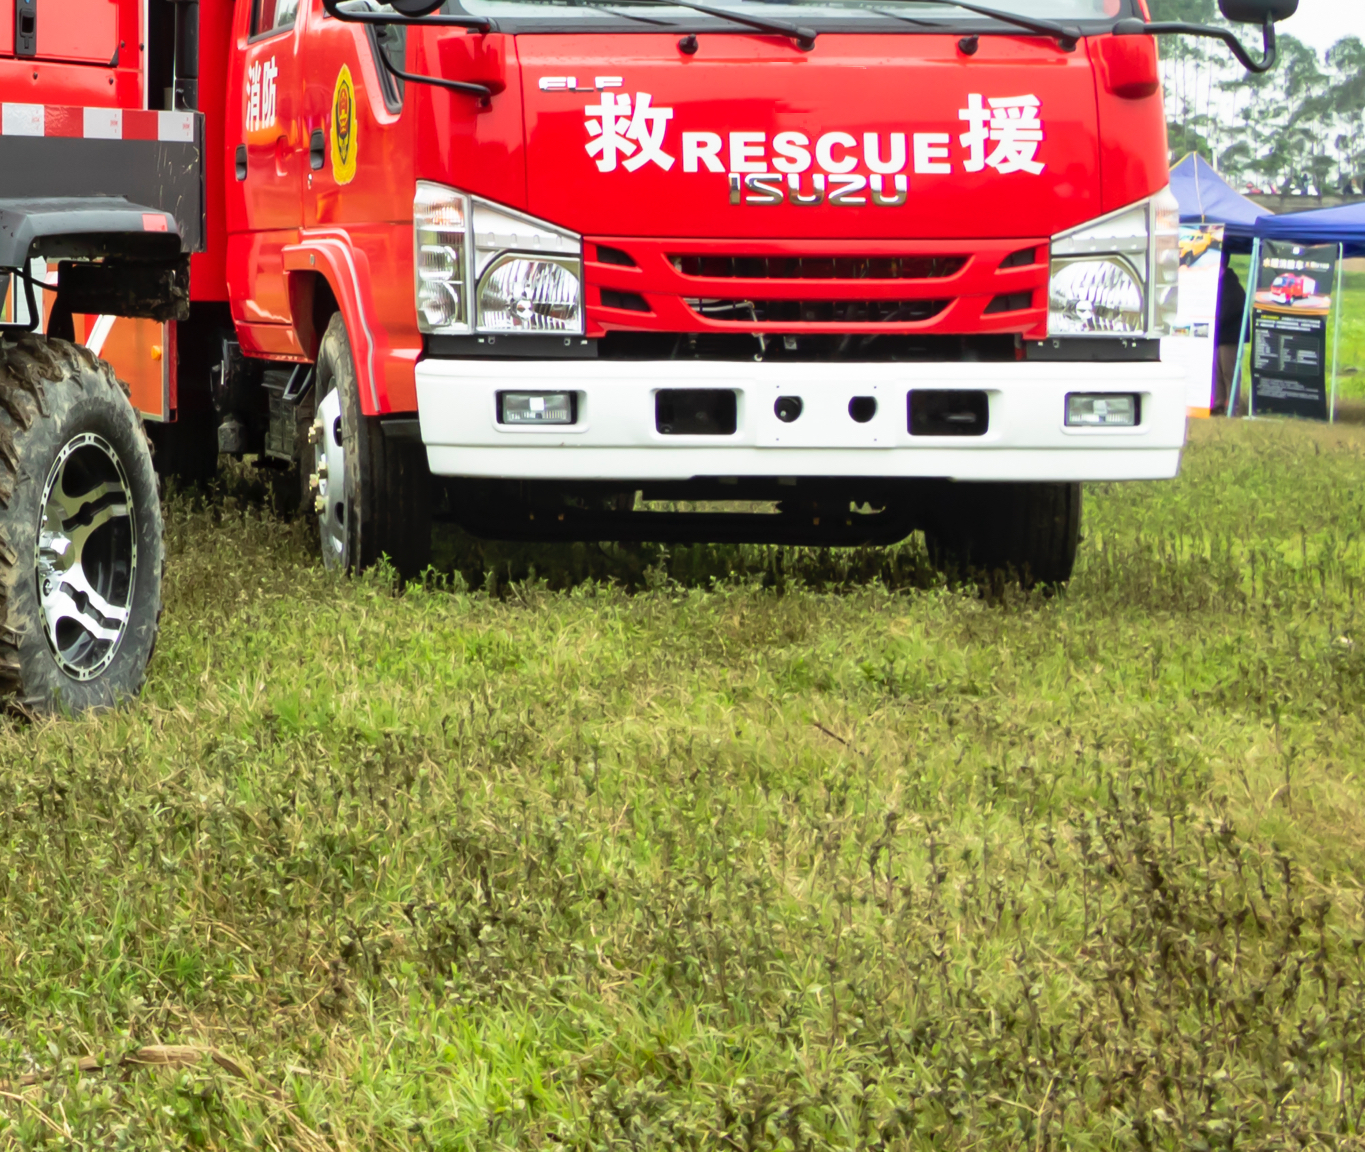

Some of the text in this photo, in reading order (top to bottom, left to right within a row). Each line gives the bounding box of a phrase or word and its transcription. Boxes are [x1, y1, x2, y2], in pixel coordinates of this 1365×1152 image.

[245, 55, 279, 132] 消防
[538, 76, 624, 92] ELF
[584, 91, 1047, 175] 救 RESCUE 援
[728, 173, 909, 207] ISUZU
